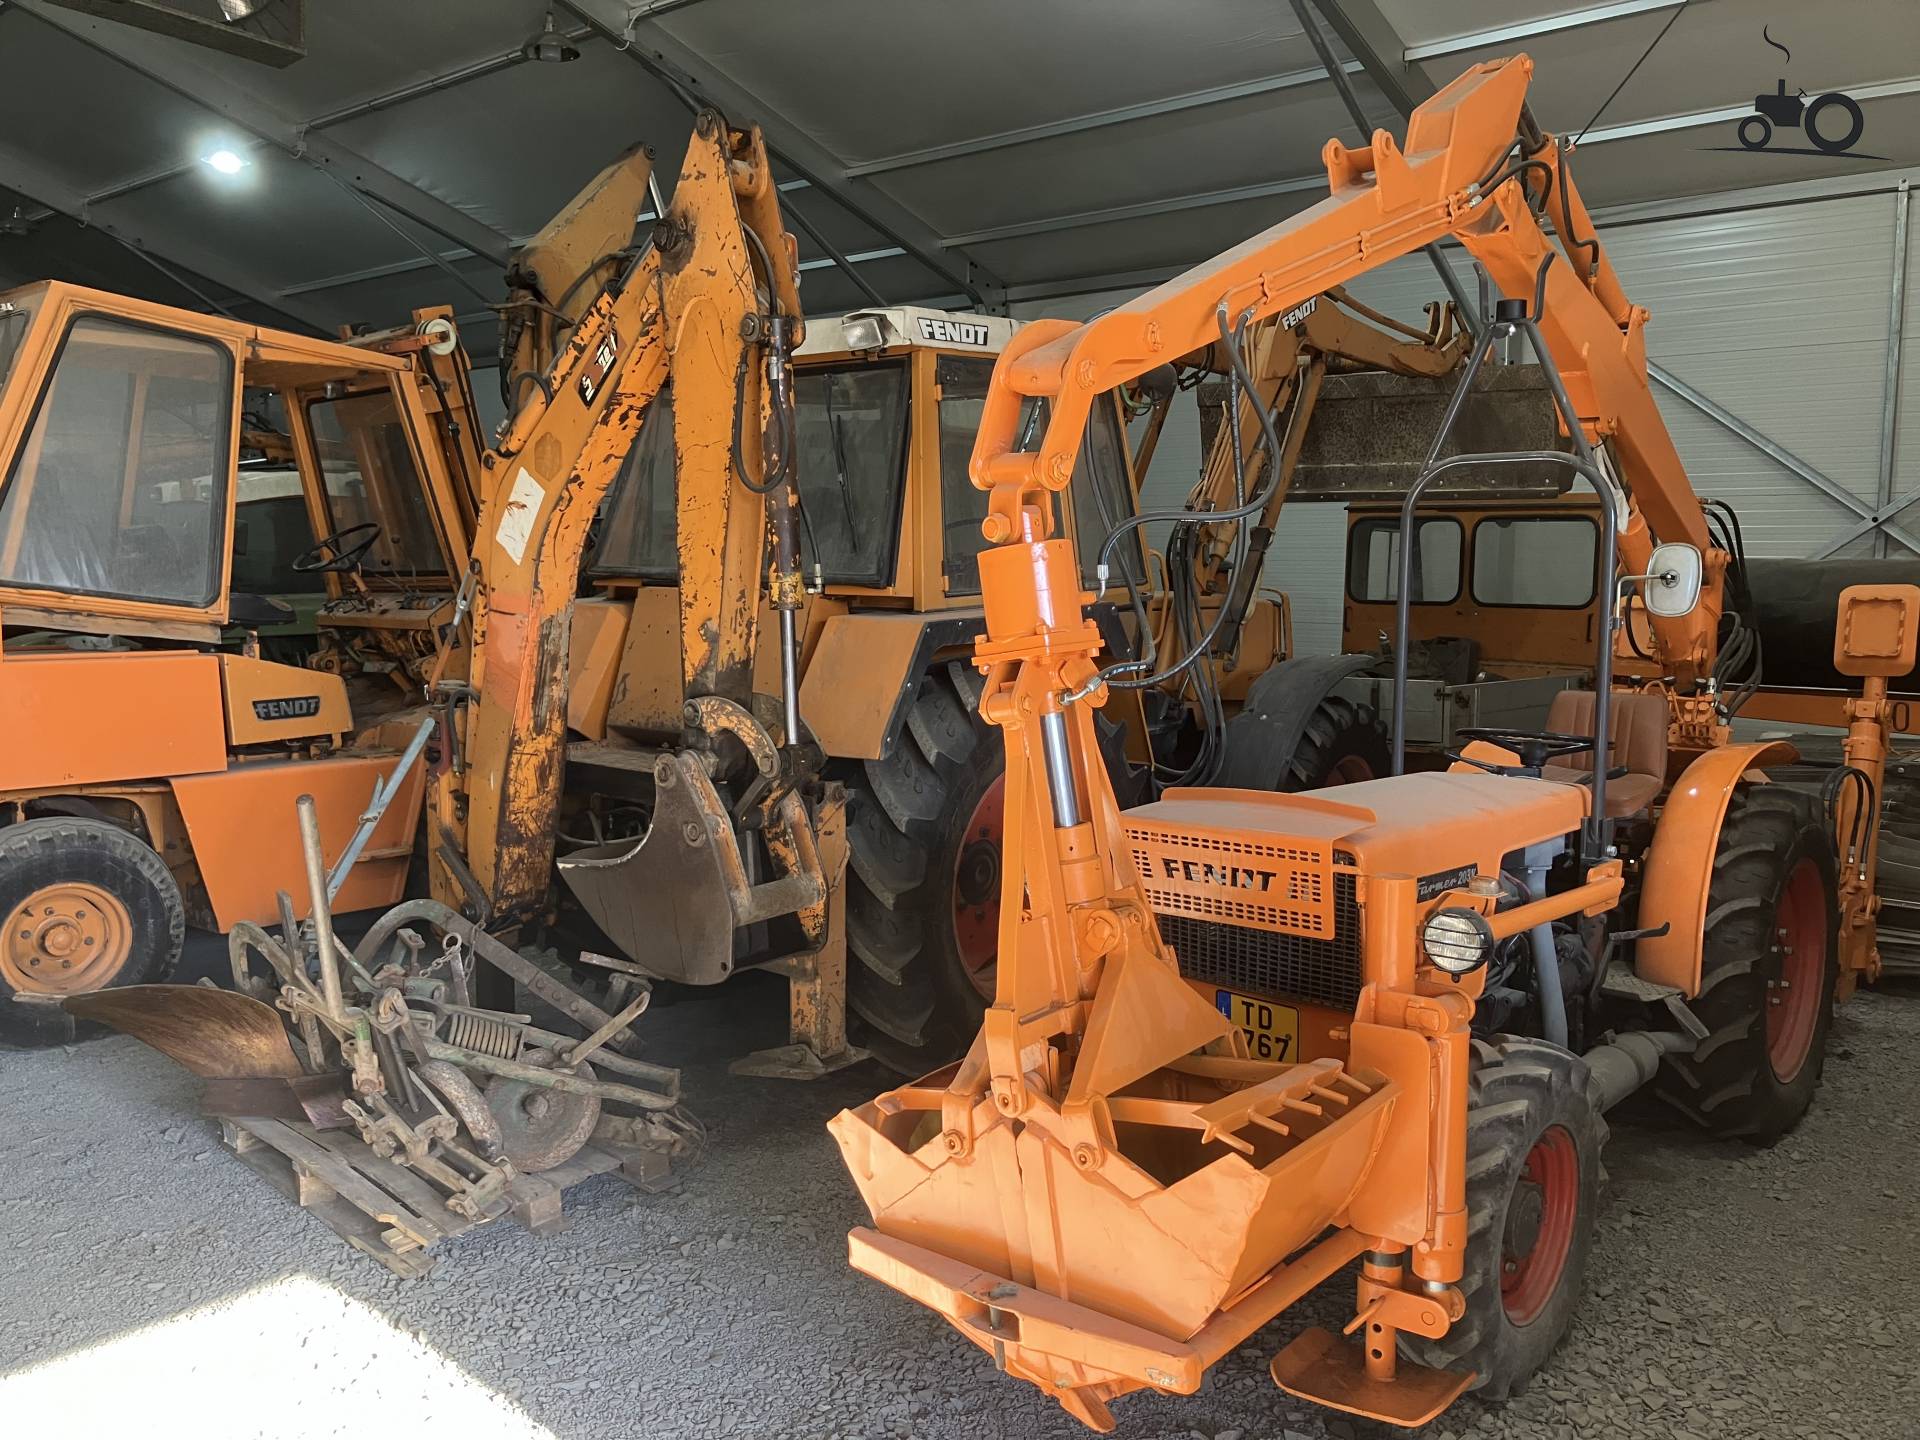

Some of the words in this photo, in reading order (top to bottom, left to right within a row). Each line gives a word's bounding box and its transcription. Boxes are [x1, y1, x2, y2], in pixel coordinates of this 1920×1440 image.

[1281, 296, 1317, 330] FENDT
[917, 318, 988, 345] FENDT
[256, 699, 319, 718] FENDT
[1161, 858, 1278, 892] FENDT
[1241, 1000, 1273, 1030] TD
